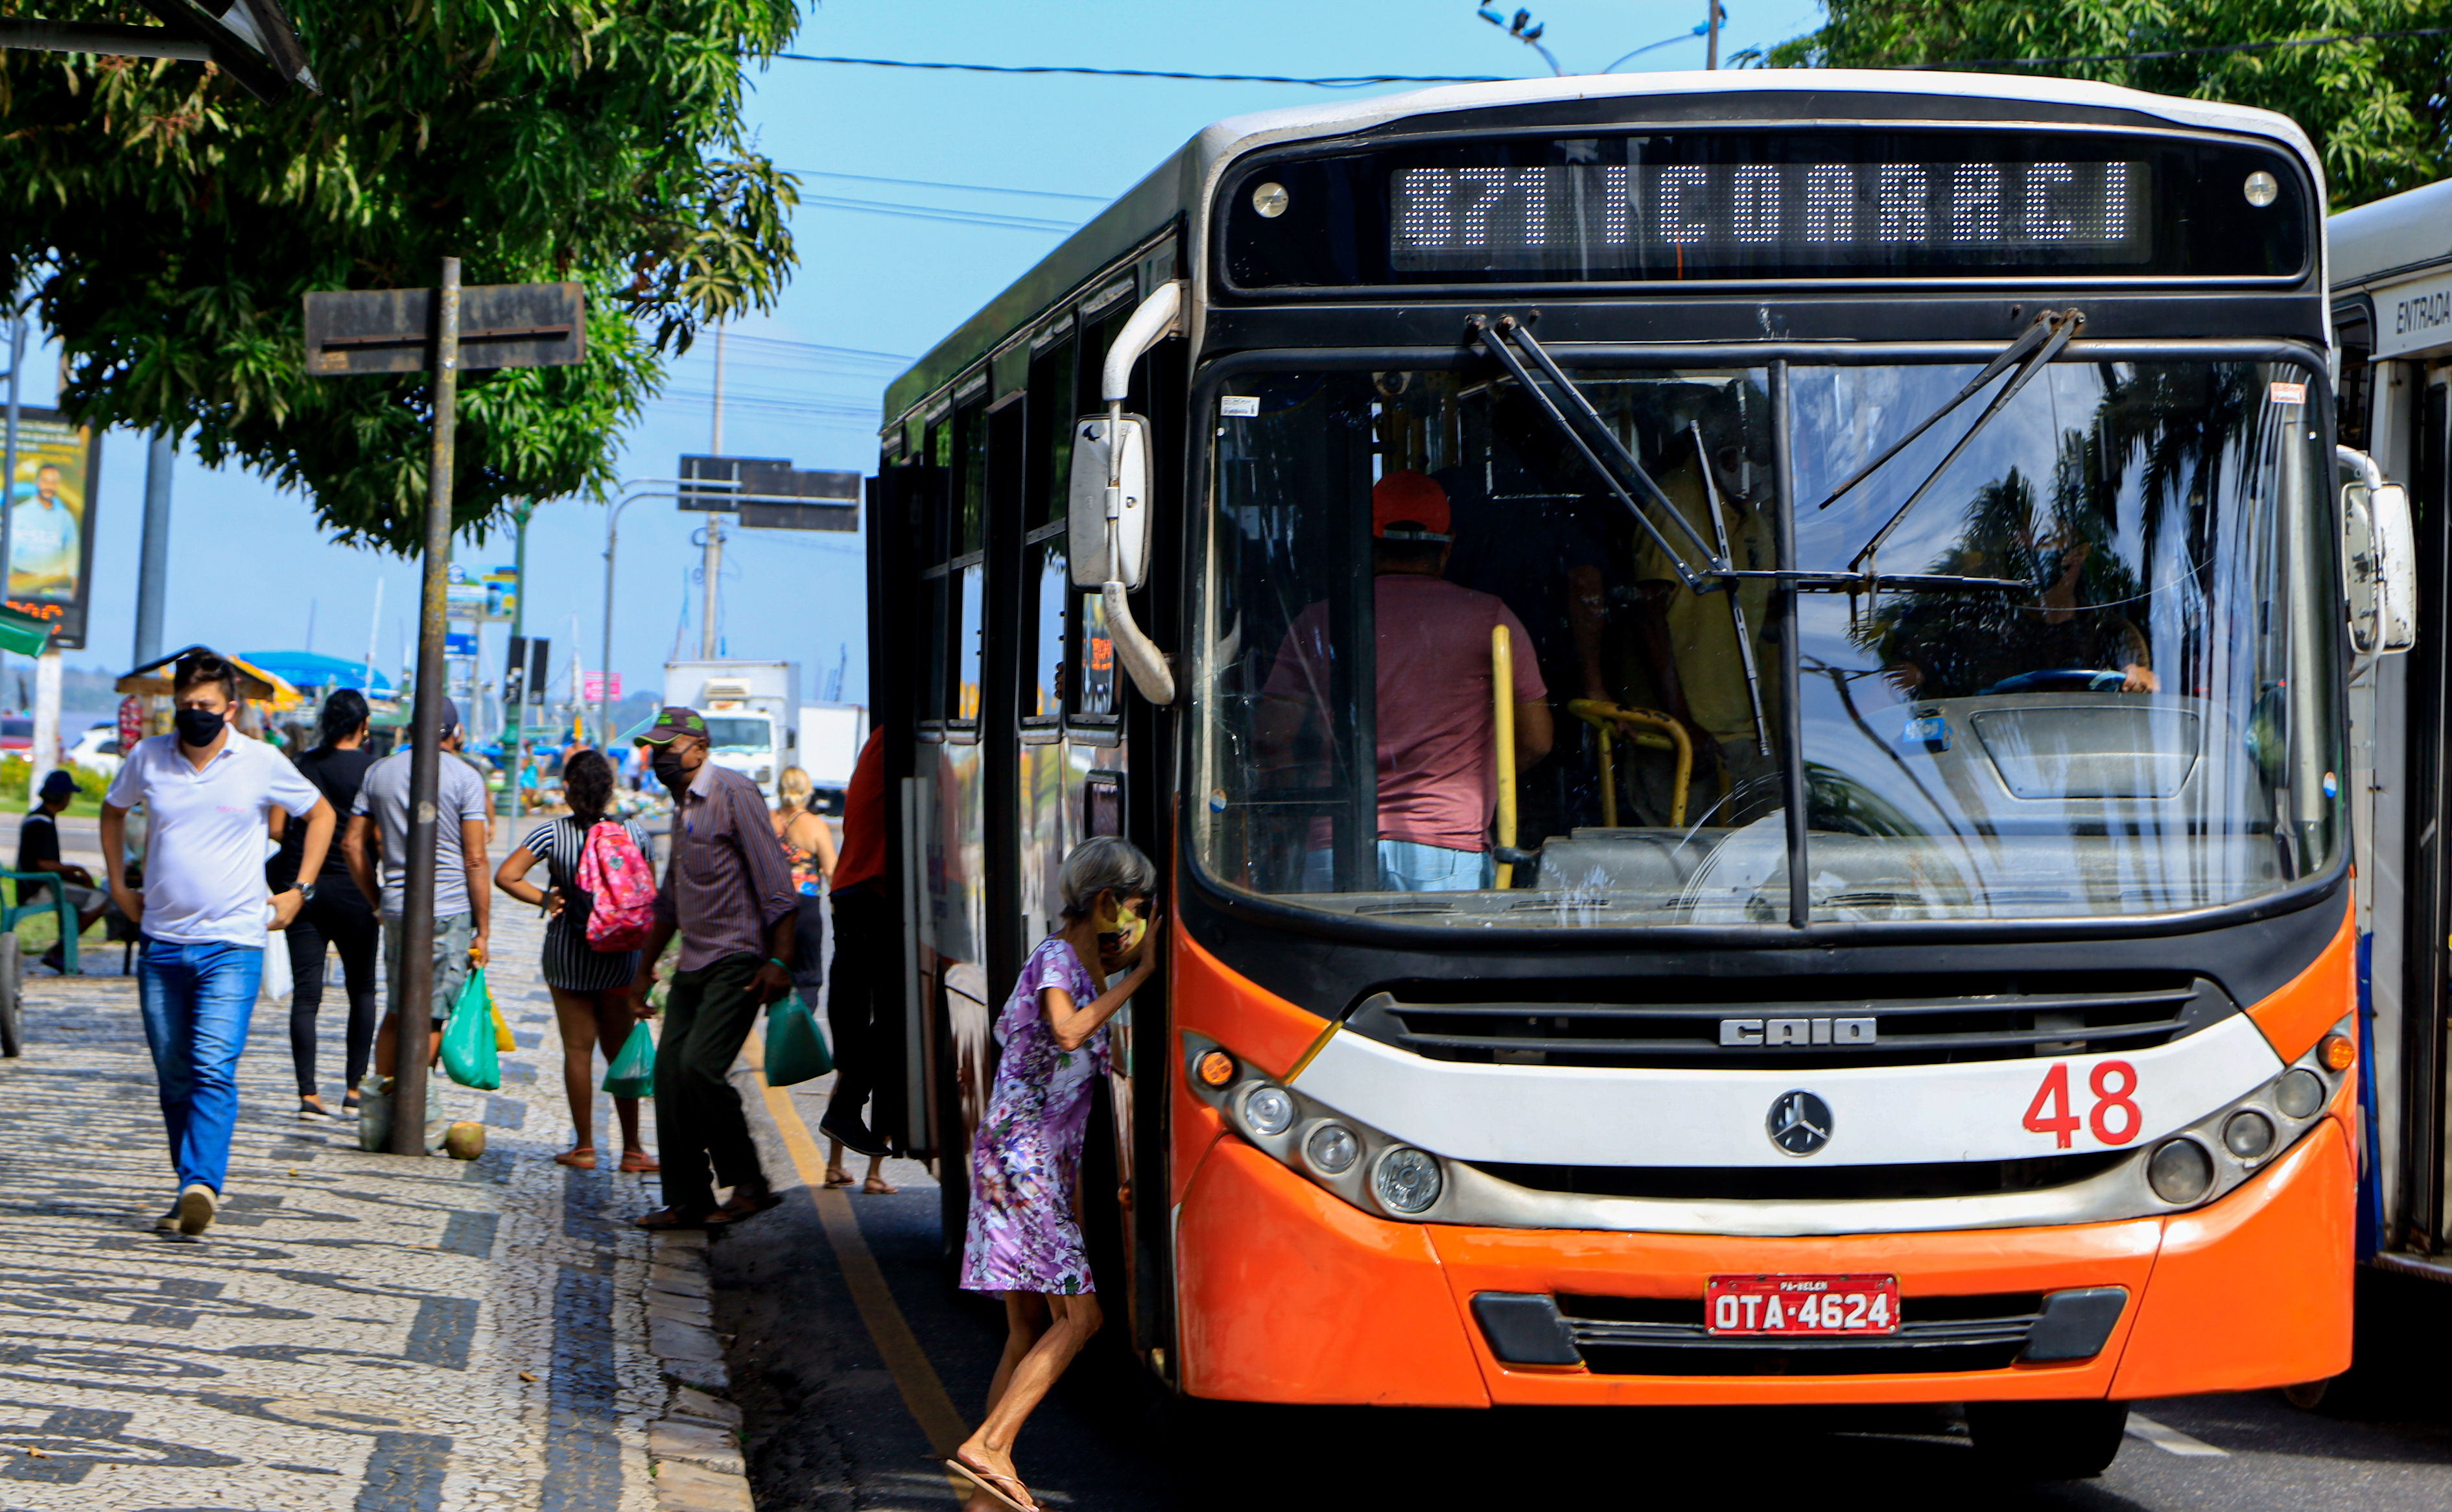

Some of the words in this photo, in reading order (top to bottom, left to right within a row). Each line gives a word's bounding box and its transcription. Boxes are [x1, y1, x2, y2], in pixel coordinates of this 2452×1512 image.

[1404, 166, 1546, 246] 871
[1605, 161, 2126, 246] ICOARACI
[2397, 290, 2451, 335] ENTRADA
[1719, 1017, 1877, 1046] CAIO
[2022, 1059, 2142, 1148] 48
[1715, 1293, 1889, 1329] OTA-4624
